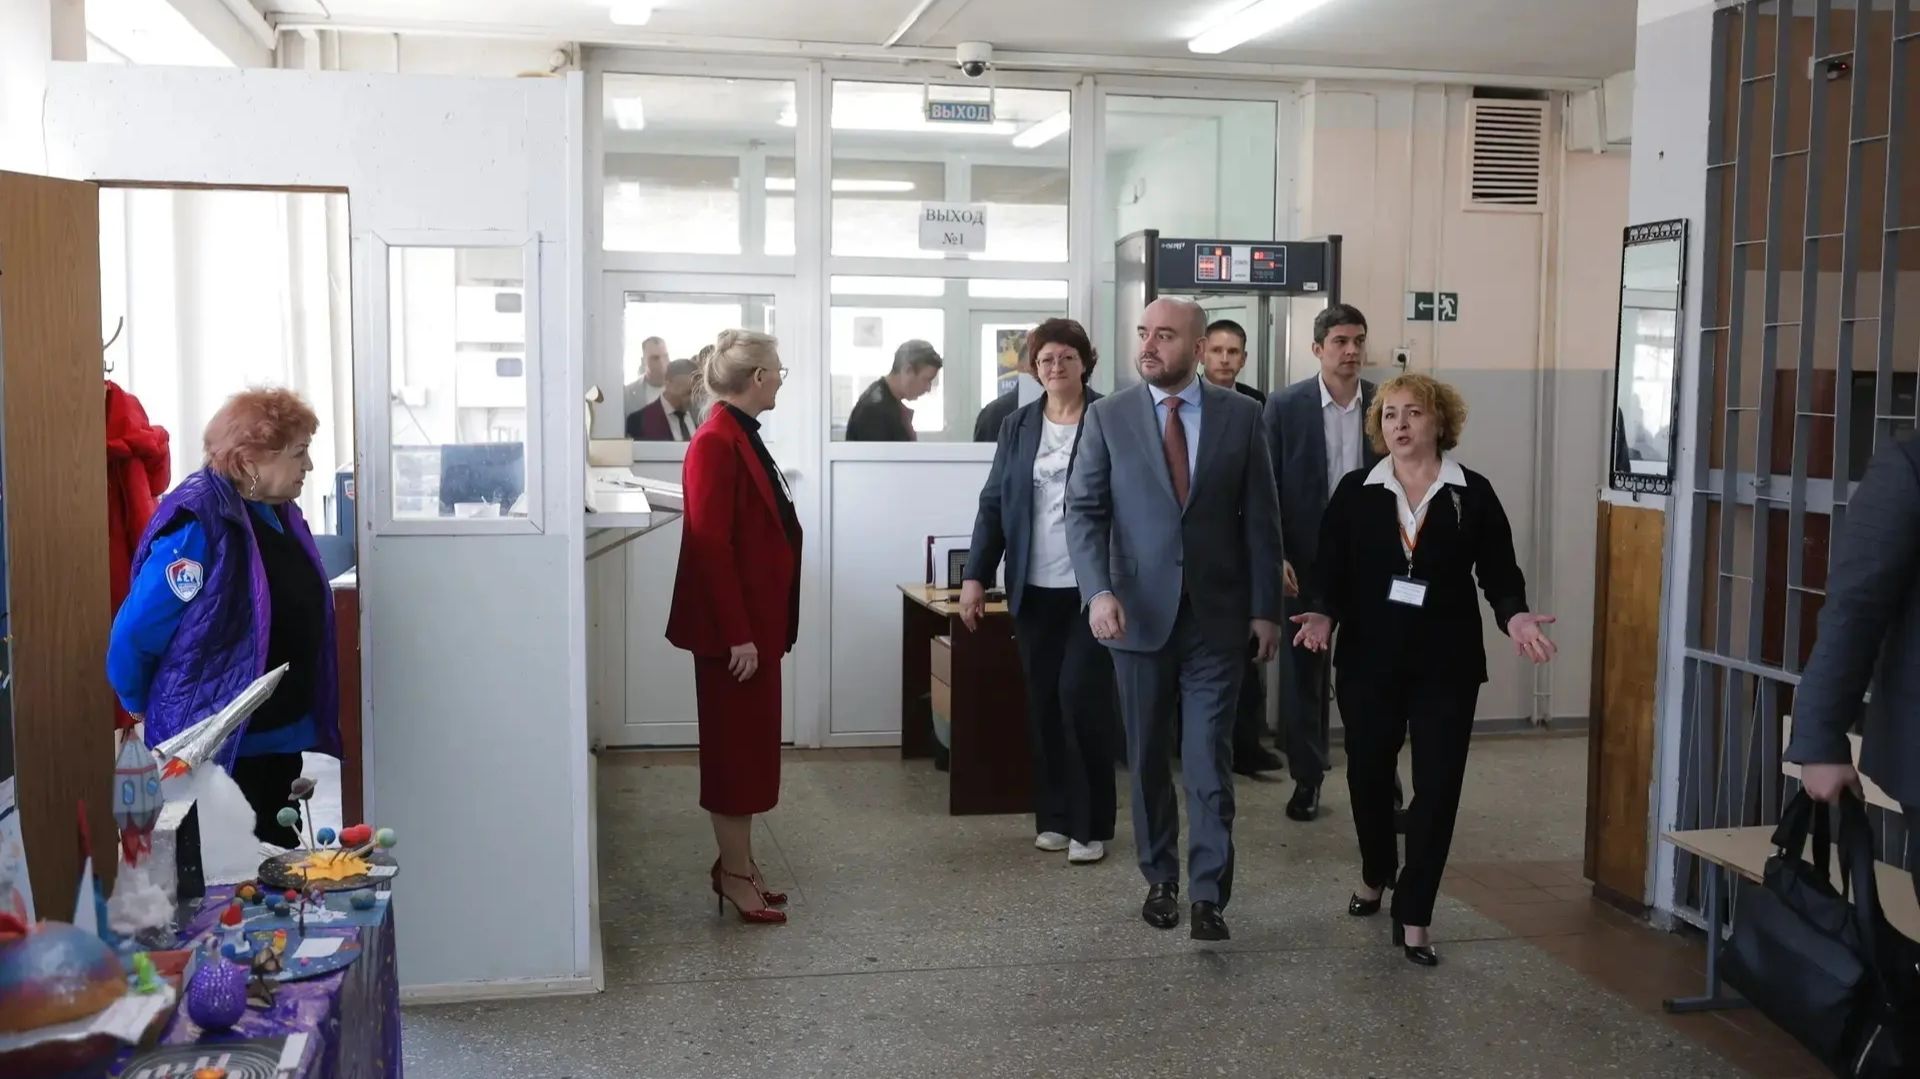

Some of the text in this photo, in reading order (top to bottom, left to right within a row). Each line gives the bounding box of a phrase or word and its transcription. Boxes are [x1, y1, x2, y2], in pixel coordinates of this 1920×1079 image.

[931, 104, 989, 121] ВЫХОД
[926, 208, 984, 226] ВЫХОД
[942, 232, 964, 246] №1
